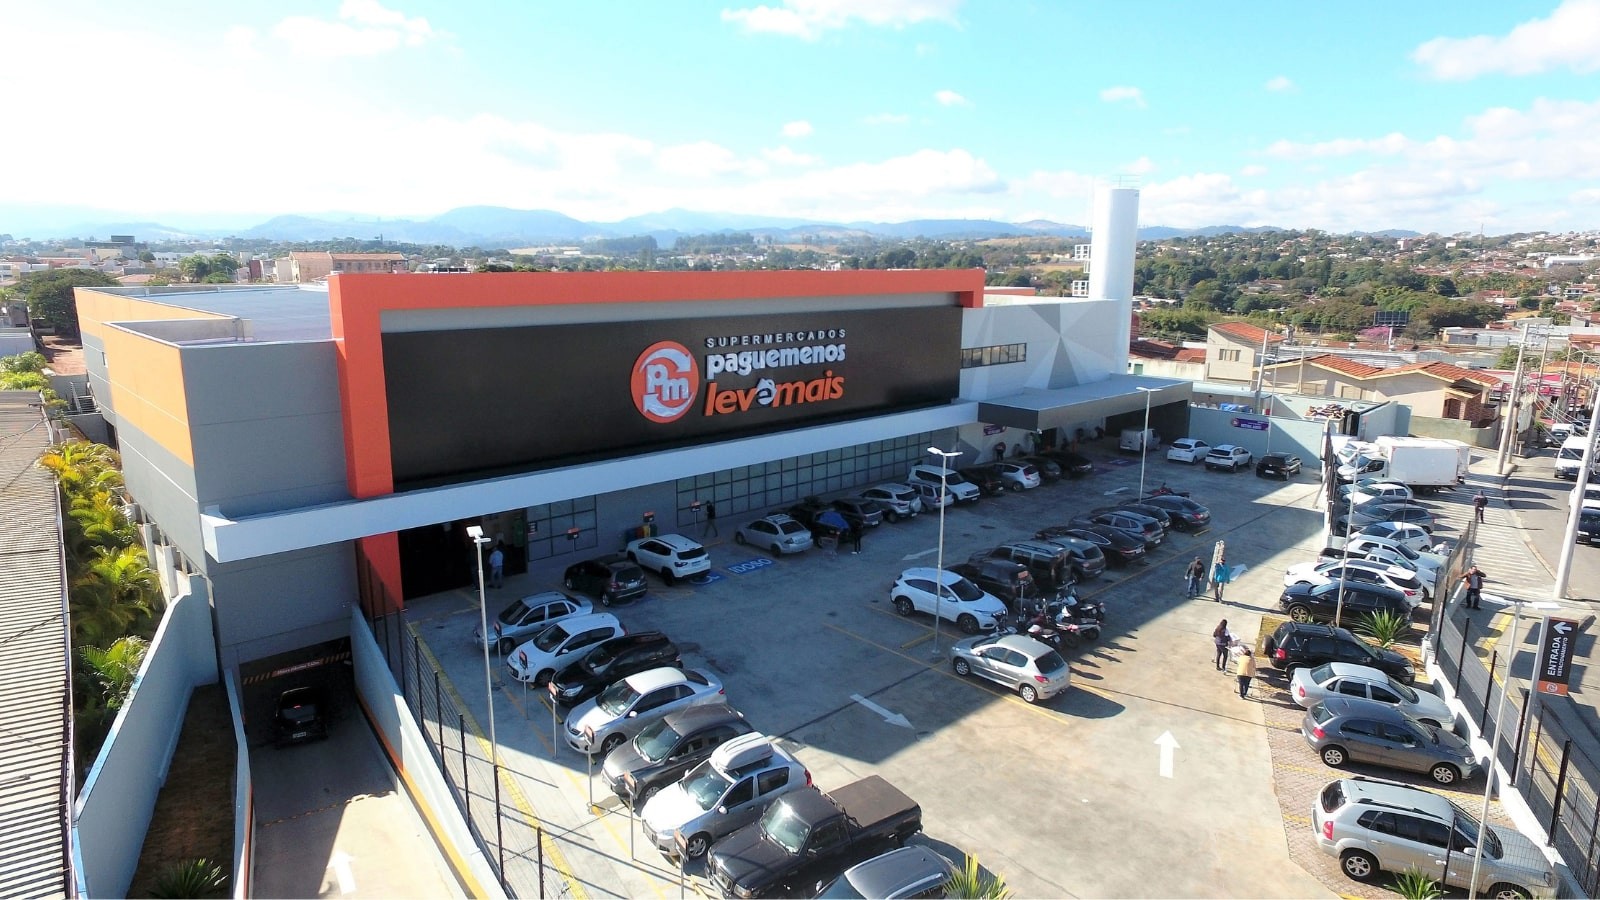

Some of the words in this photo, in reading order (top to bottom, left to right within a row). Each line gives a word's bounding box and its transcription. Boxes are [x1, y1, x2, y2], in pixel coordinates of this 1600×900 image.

[706, 329, 846, 348] SUPERMERCADOS
[706, 344, 846, 379] paguemenos
[728, 559, 772, 573] IDOSO
[1548, 637, 1561, 676] ENTRADA
[1557, 637, 1568, 677] ESTACIONAMENTO
